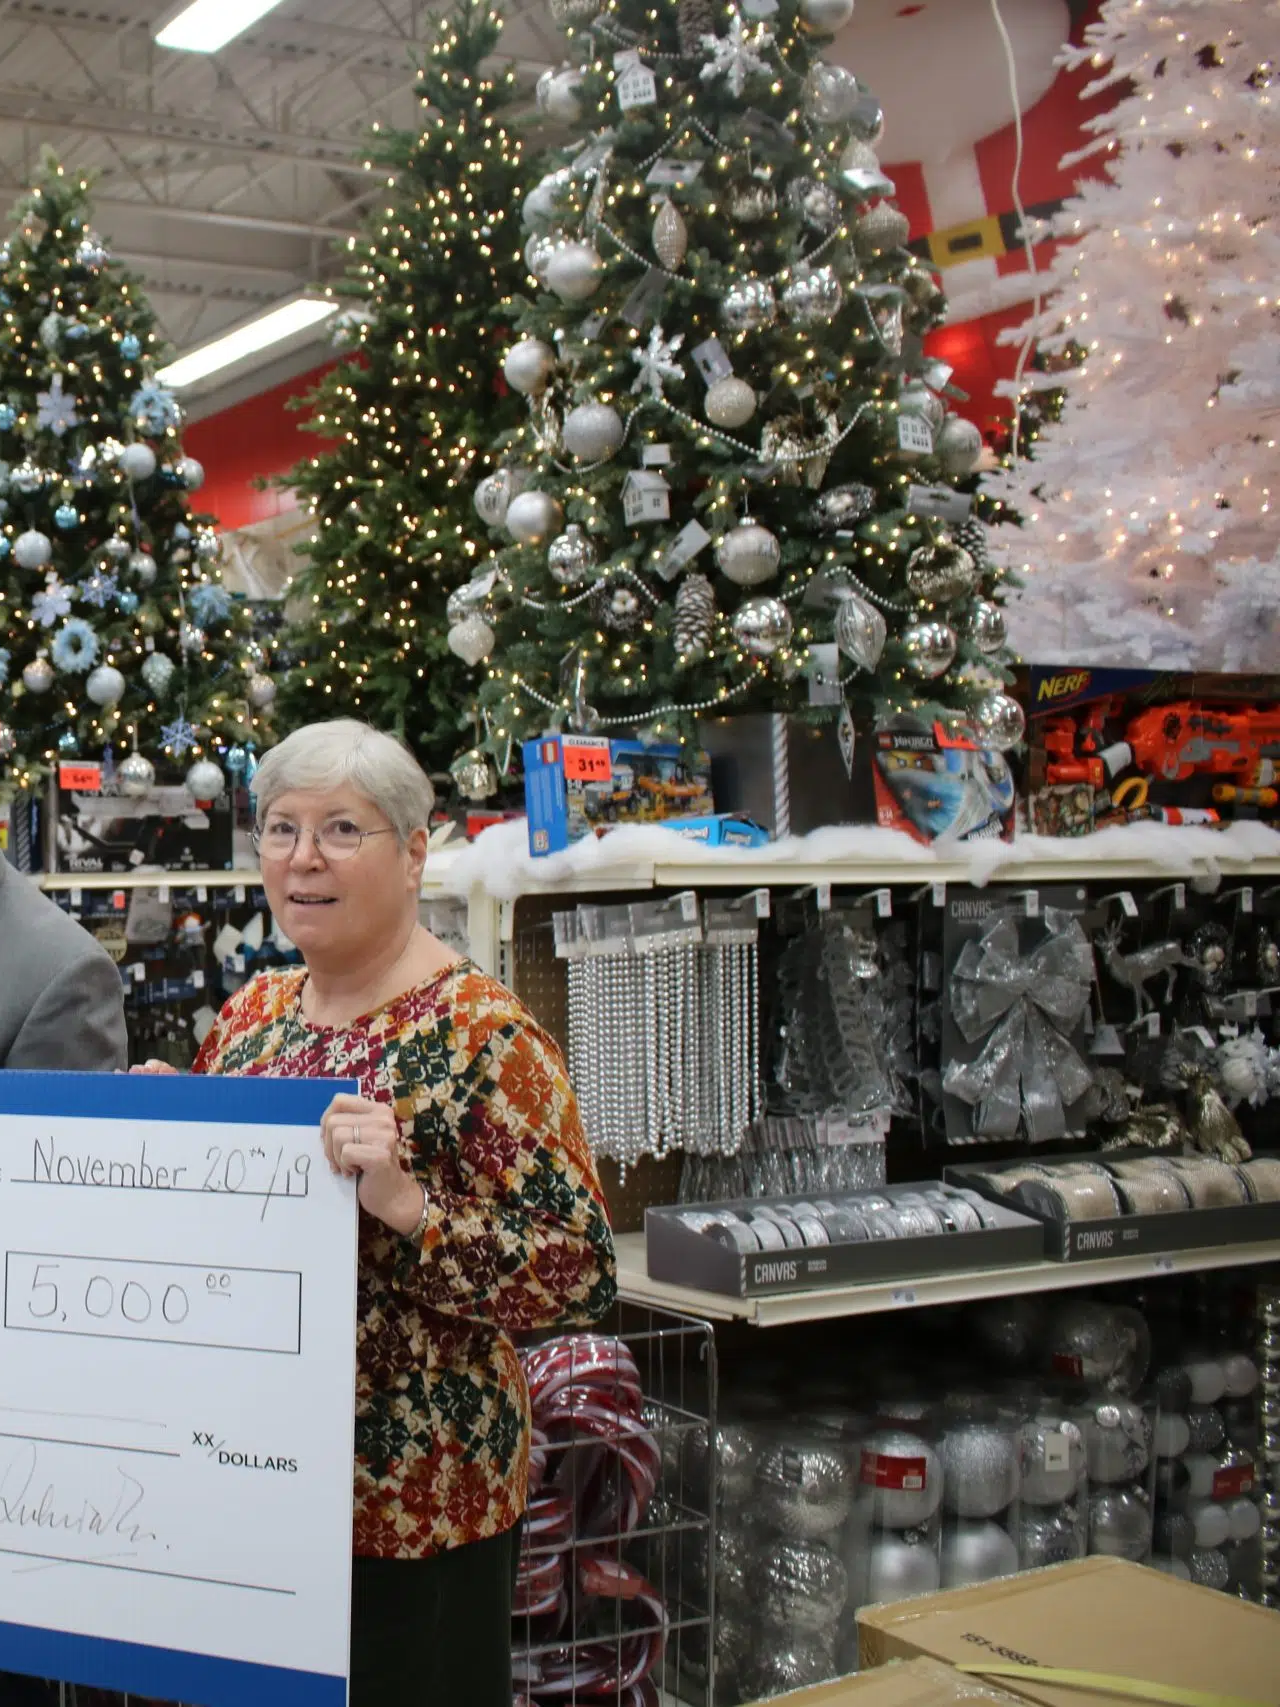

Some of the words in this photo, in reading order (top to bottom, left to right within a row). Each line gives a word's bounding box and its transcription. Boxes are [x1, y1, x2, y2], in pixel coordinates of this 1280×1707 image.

[1037, 671, 1091, 701] NERF
[70, 857, 104, 868] RIVAL
[951, 900, 992, 918] CANVAS
[32, 1136, 187, 1190] November
[1077, 1230, 1114, 1249] CANVAS
[754, 1260, 798, 1284] CANVAS
[218, 1450, 298, 1473] DOLLARS
